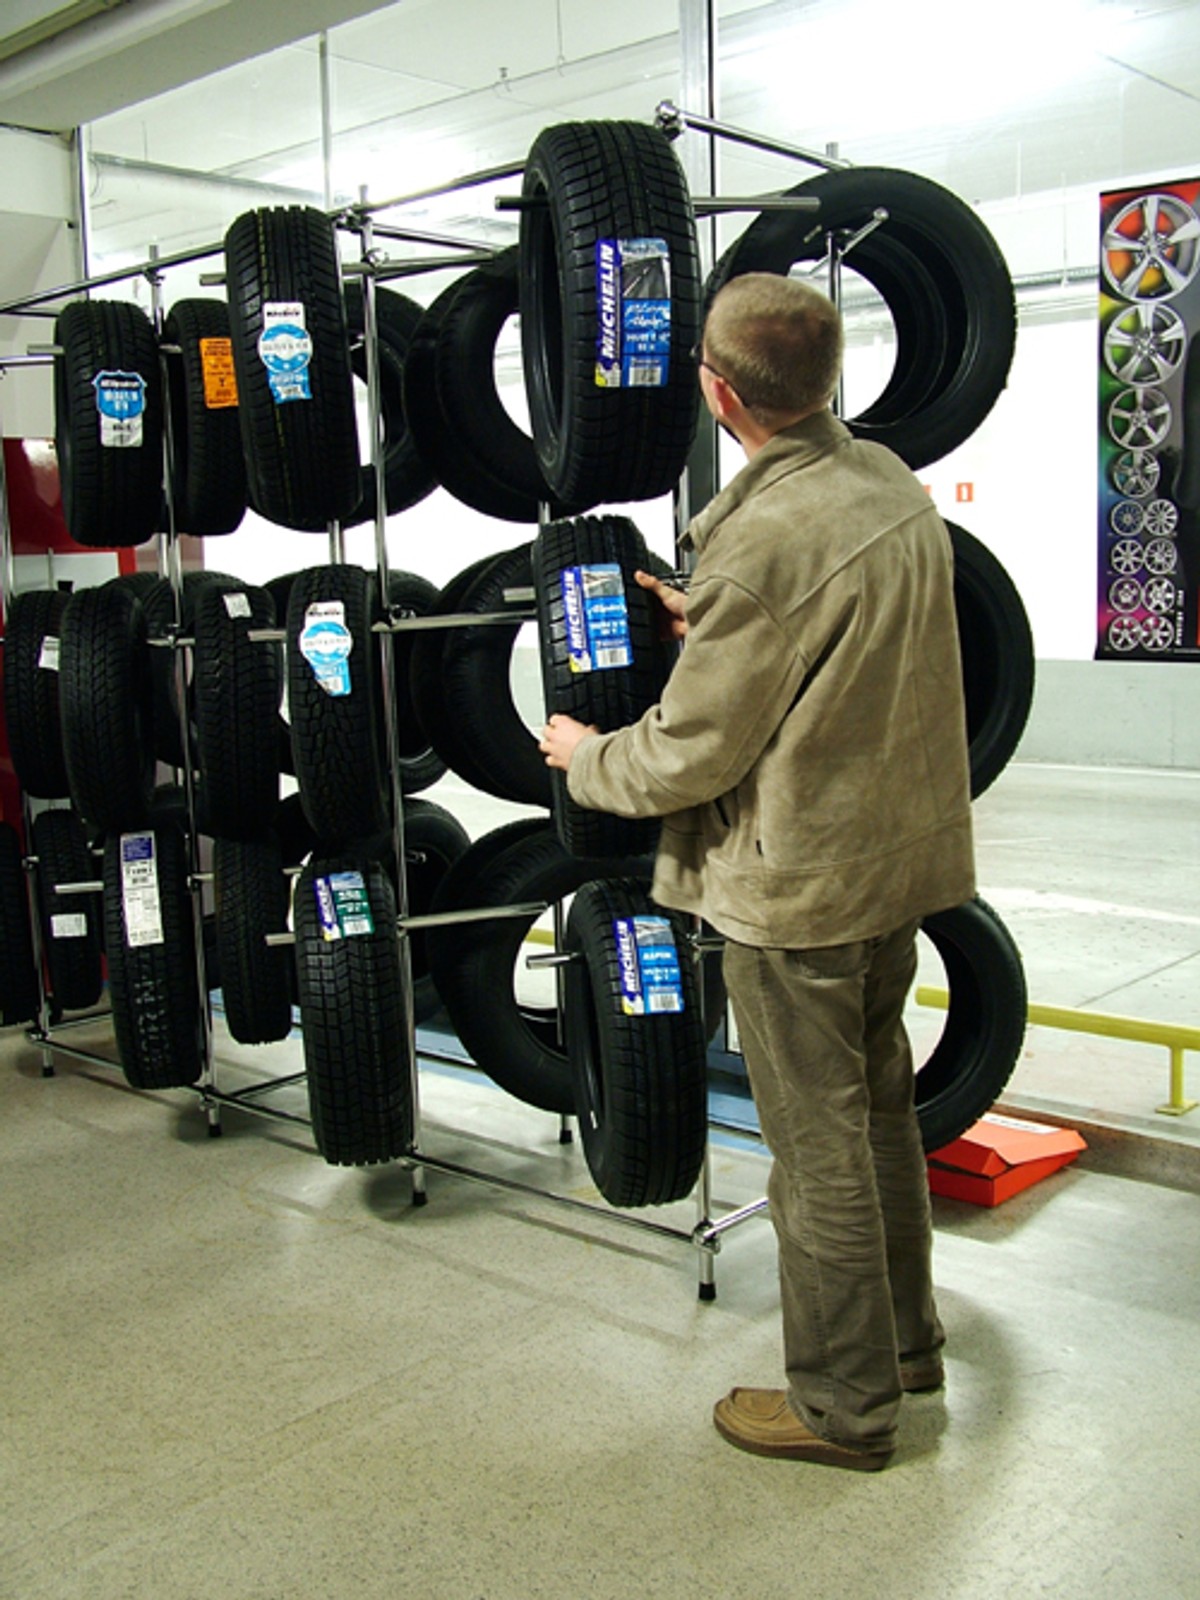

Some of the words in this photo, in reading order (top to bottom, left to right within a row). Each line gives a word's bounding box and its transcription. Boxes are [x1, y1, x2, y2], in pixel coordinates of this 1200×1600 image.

[600, 244, 615, 359] MICHELIN
[564, 570, 586, 650] MICHELIN
[616, 920, 638, 993] MICHELIN
